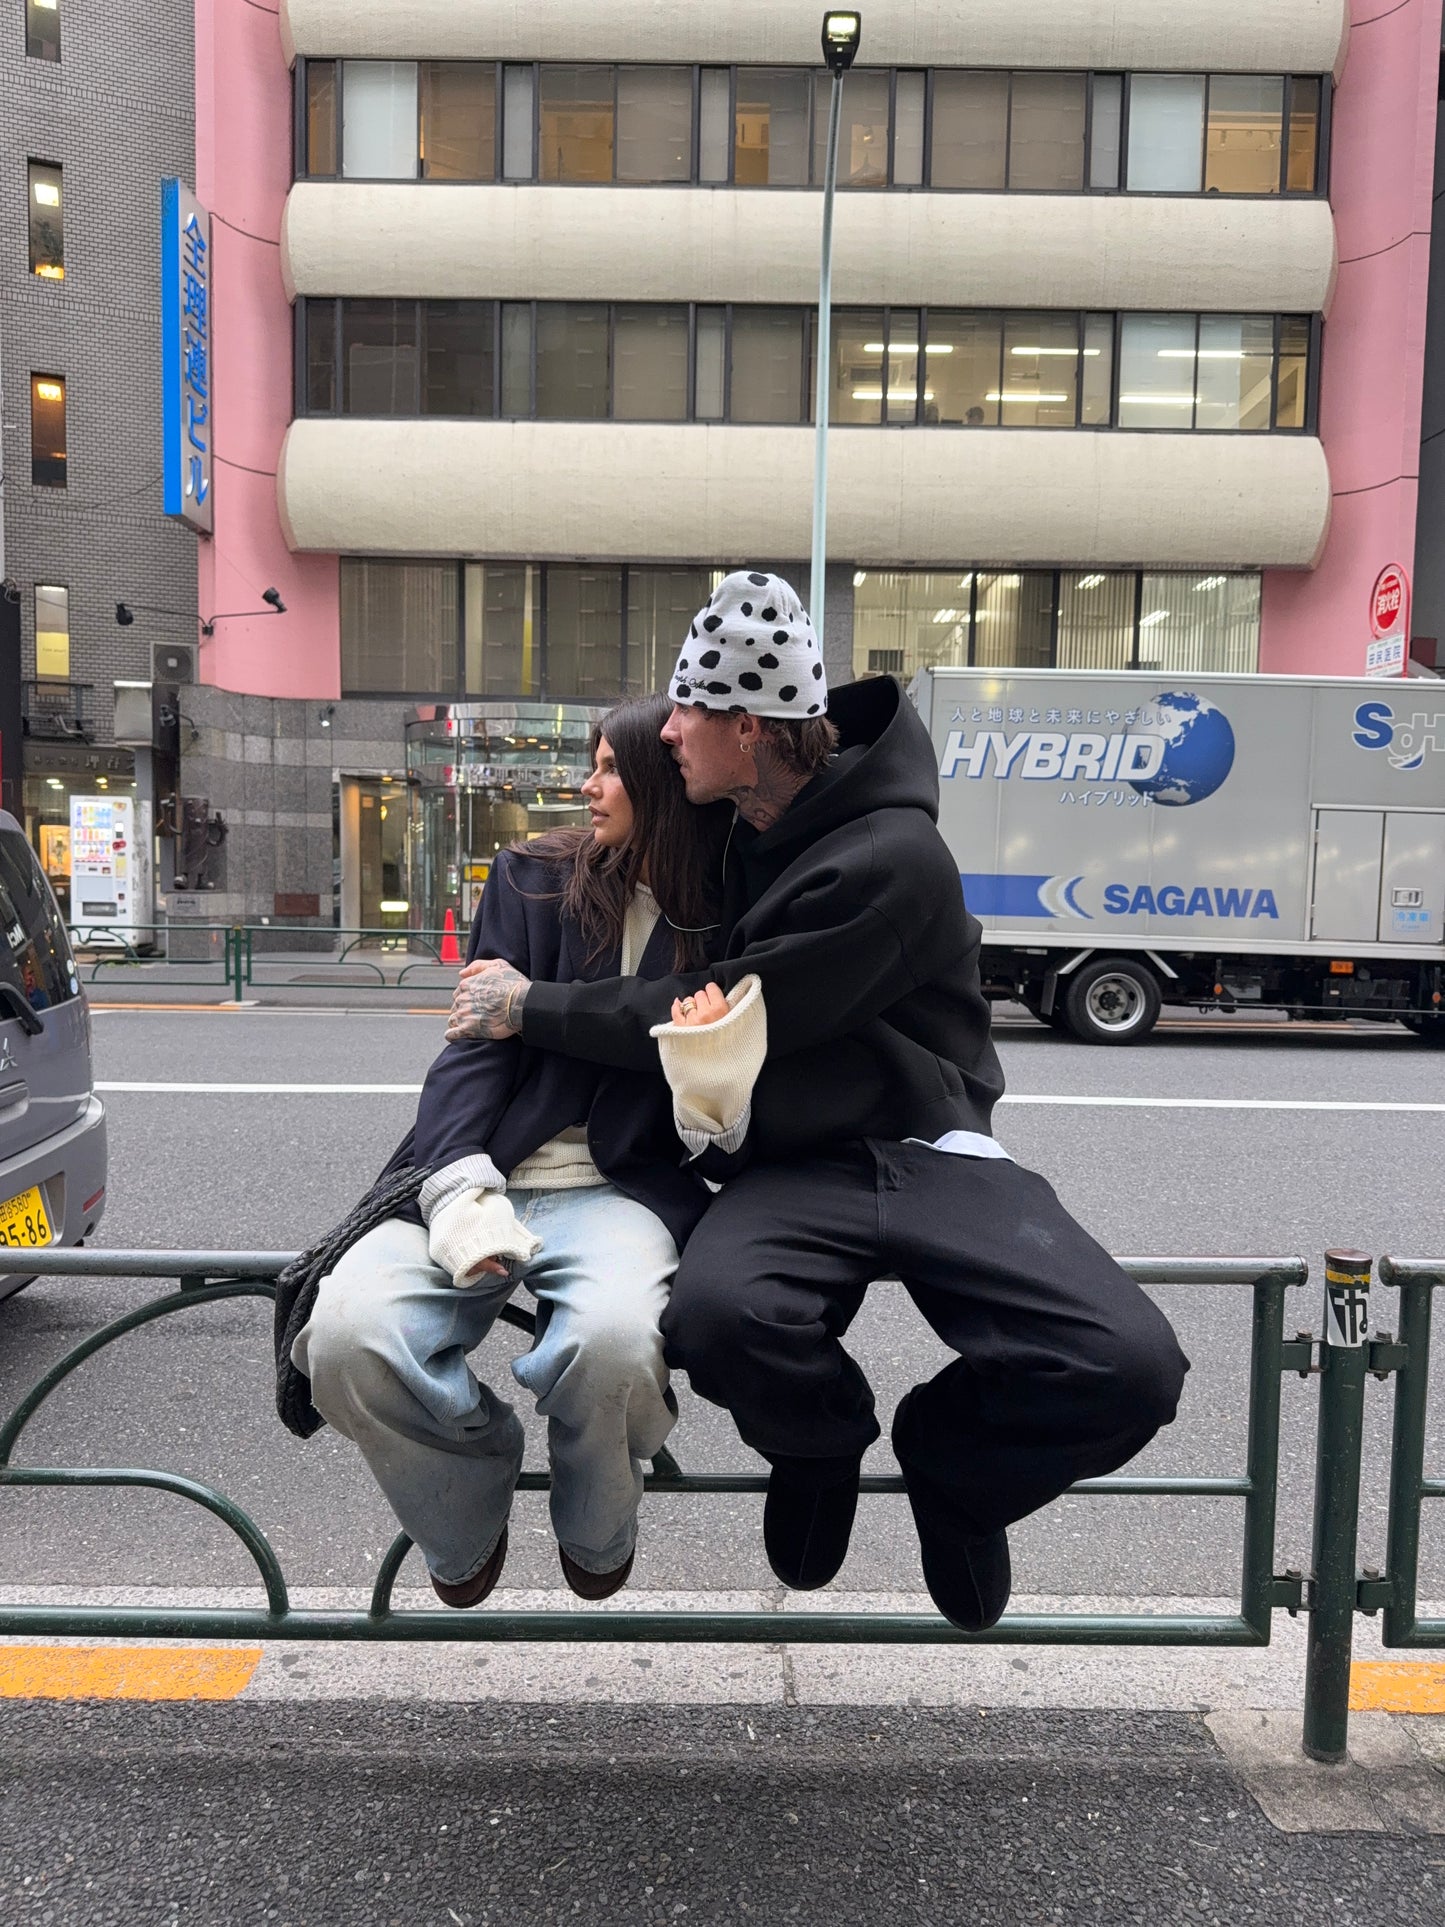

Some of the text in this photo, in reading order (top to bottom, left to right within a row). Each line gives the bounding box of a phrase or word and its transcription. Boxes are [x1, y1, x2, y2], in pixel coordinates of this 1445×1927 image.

[182, 213, 209, 507] 全理連ビル
[951, 707, 1172, 725] 人と地球と未来にやさしい
[939, 731, 1167, 782] HYBRID
[1059, 790, 1155, 807] ハイブリッド
[1103, 884, 1280, 919] SAGAWA
